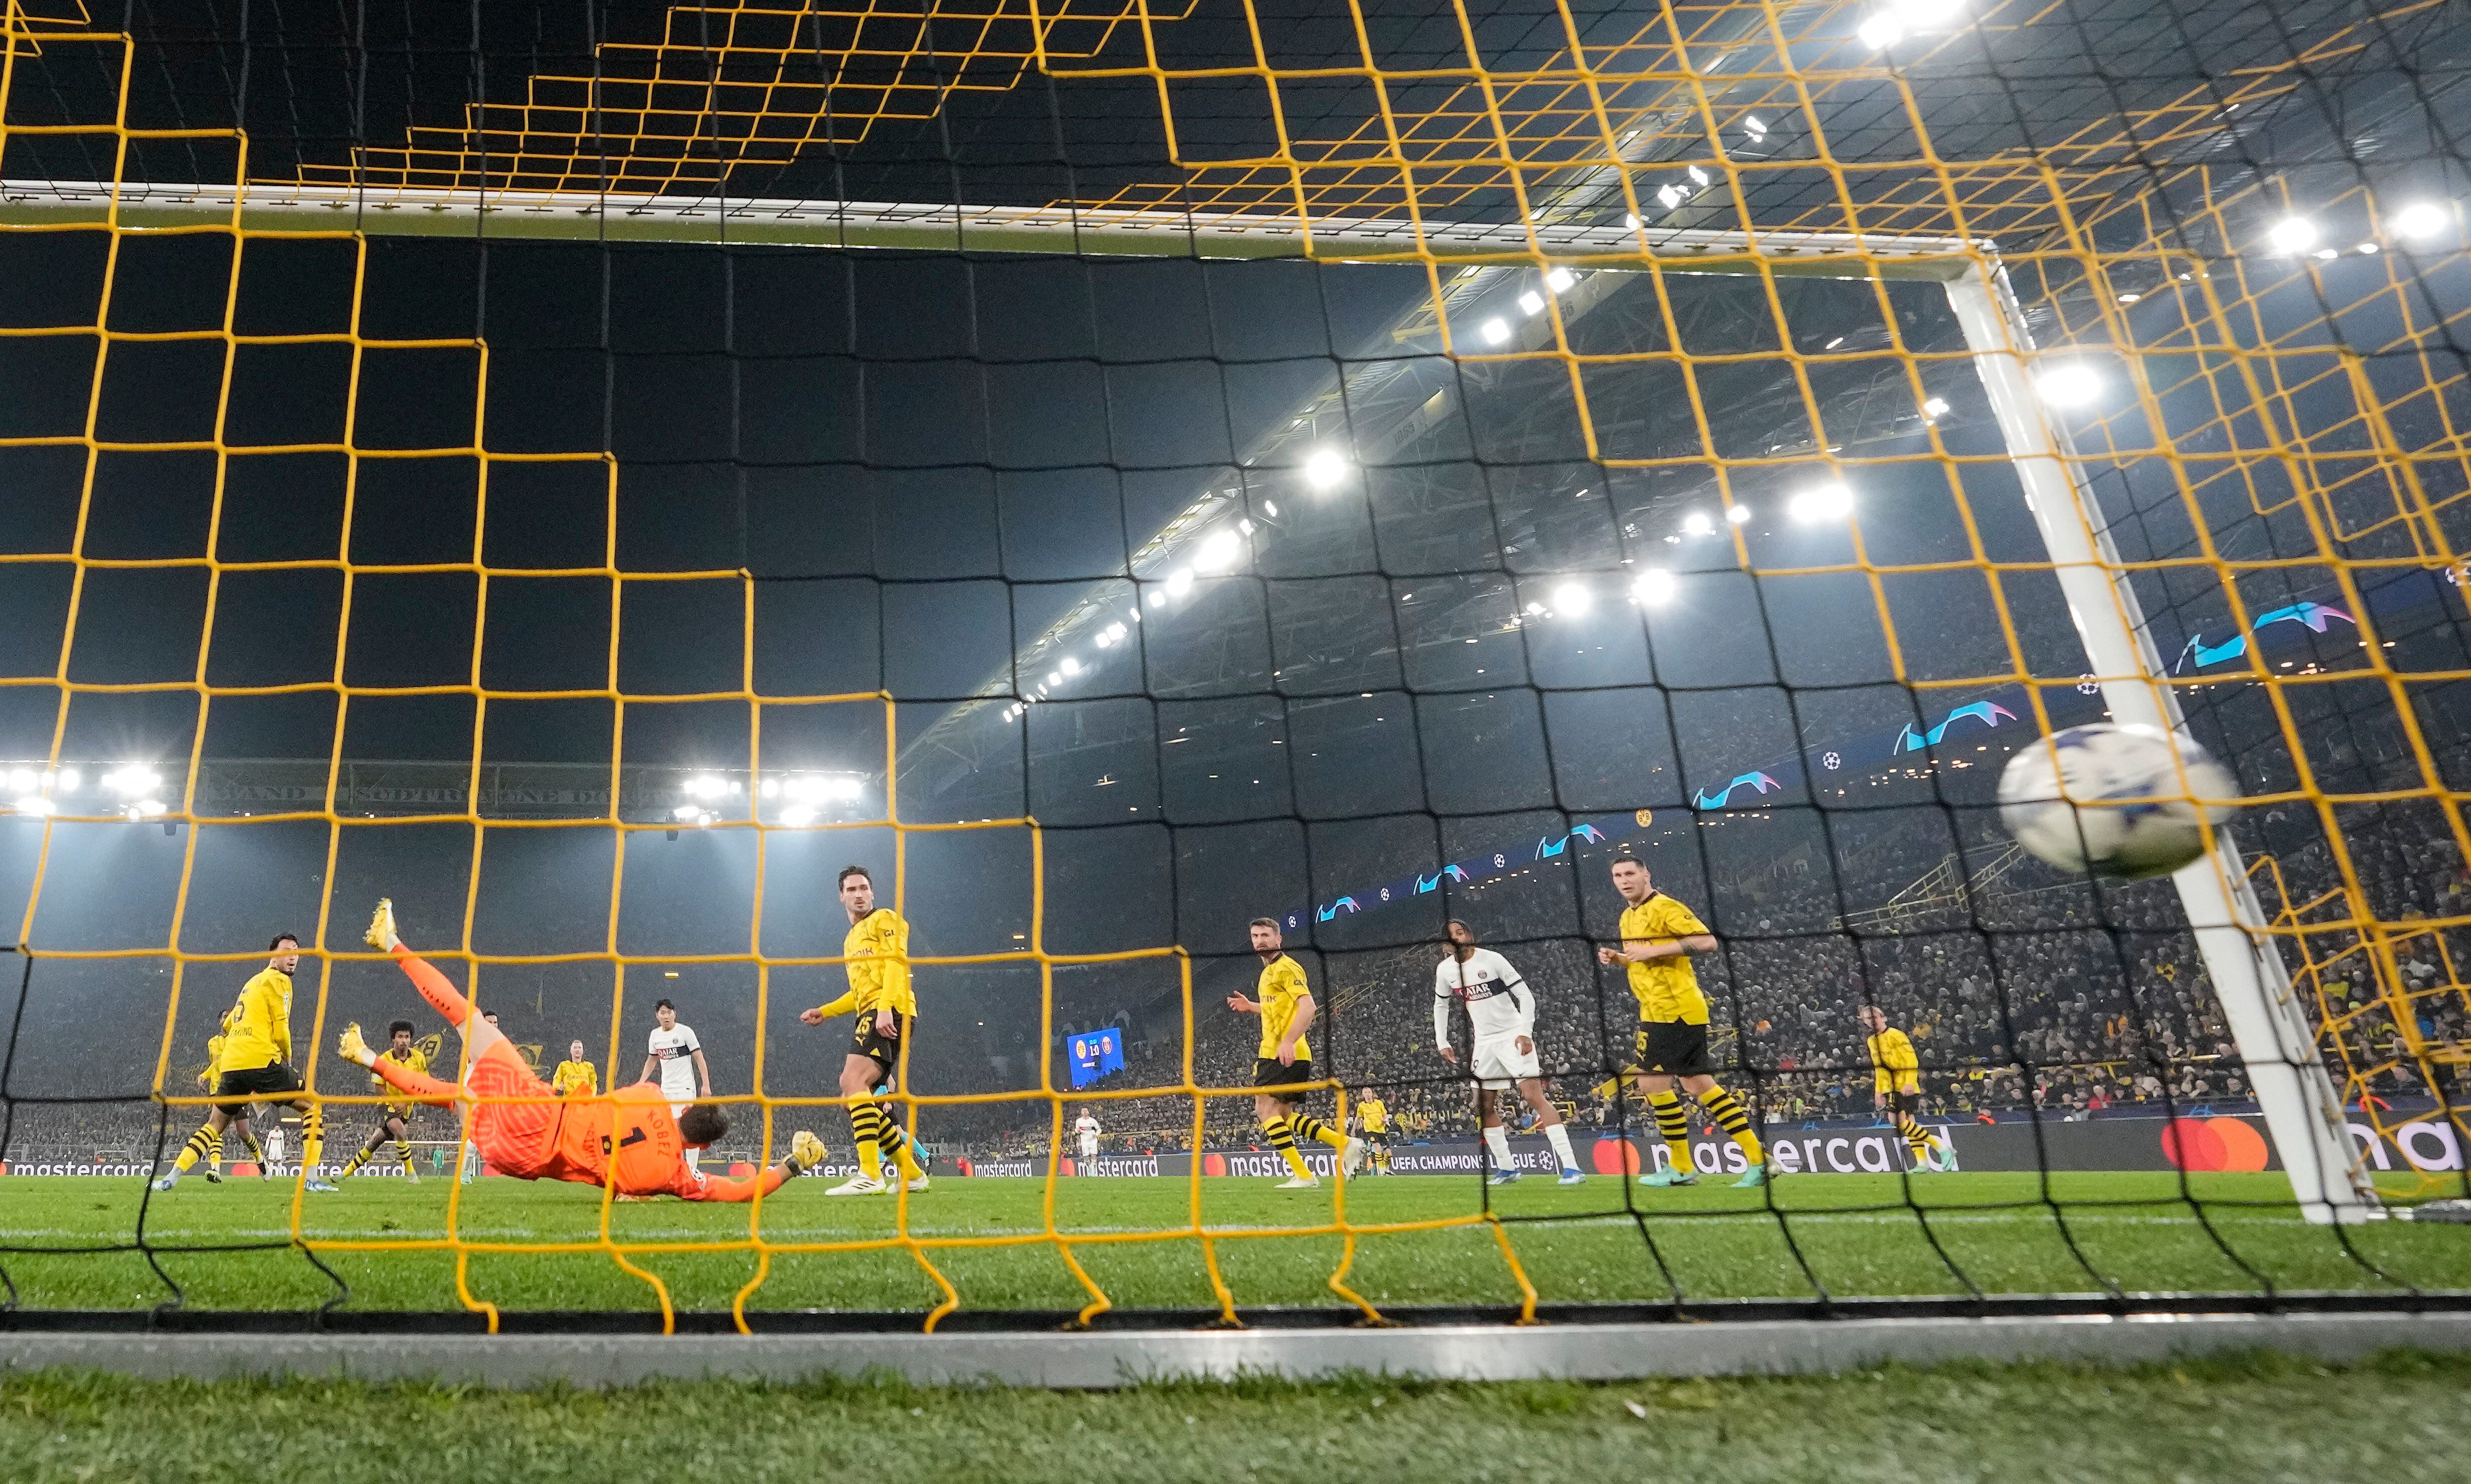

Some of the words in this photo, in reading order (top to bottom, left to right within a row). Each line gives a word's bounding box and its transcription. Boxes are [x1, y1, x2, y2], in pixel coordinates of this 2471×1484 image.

[855, 1016, 873, 1035] 15
[14, 1162, 153, 1176] mastercard
[975, 1159, 1031, 1177] mastercard
[1390, 1157, 1418, 1170] UEFA
[1489, 1153, 1537, 1169] LGUE
